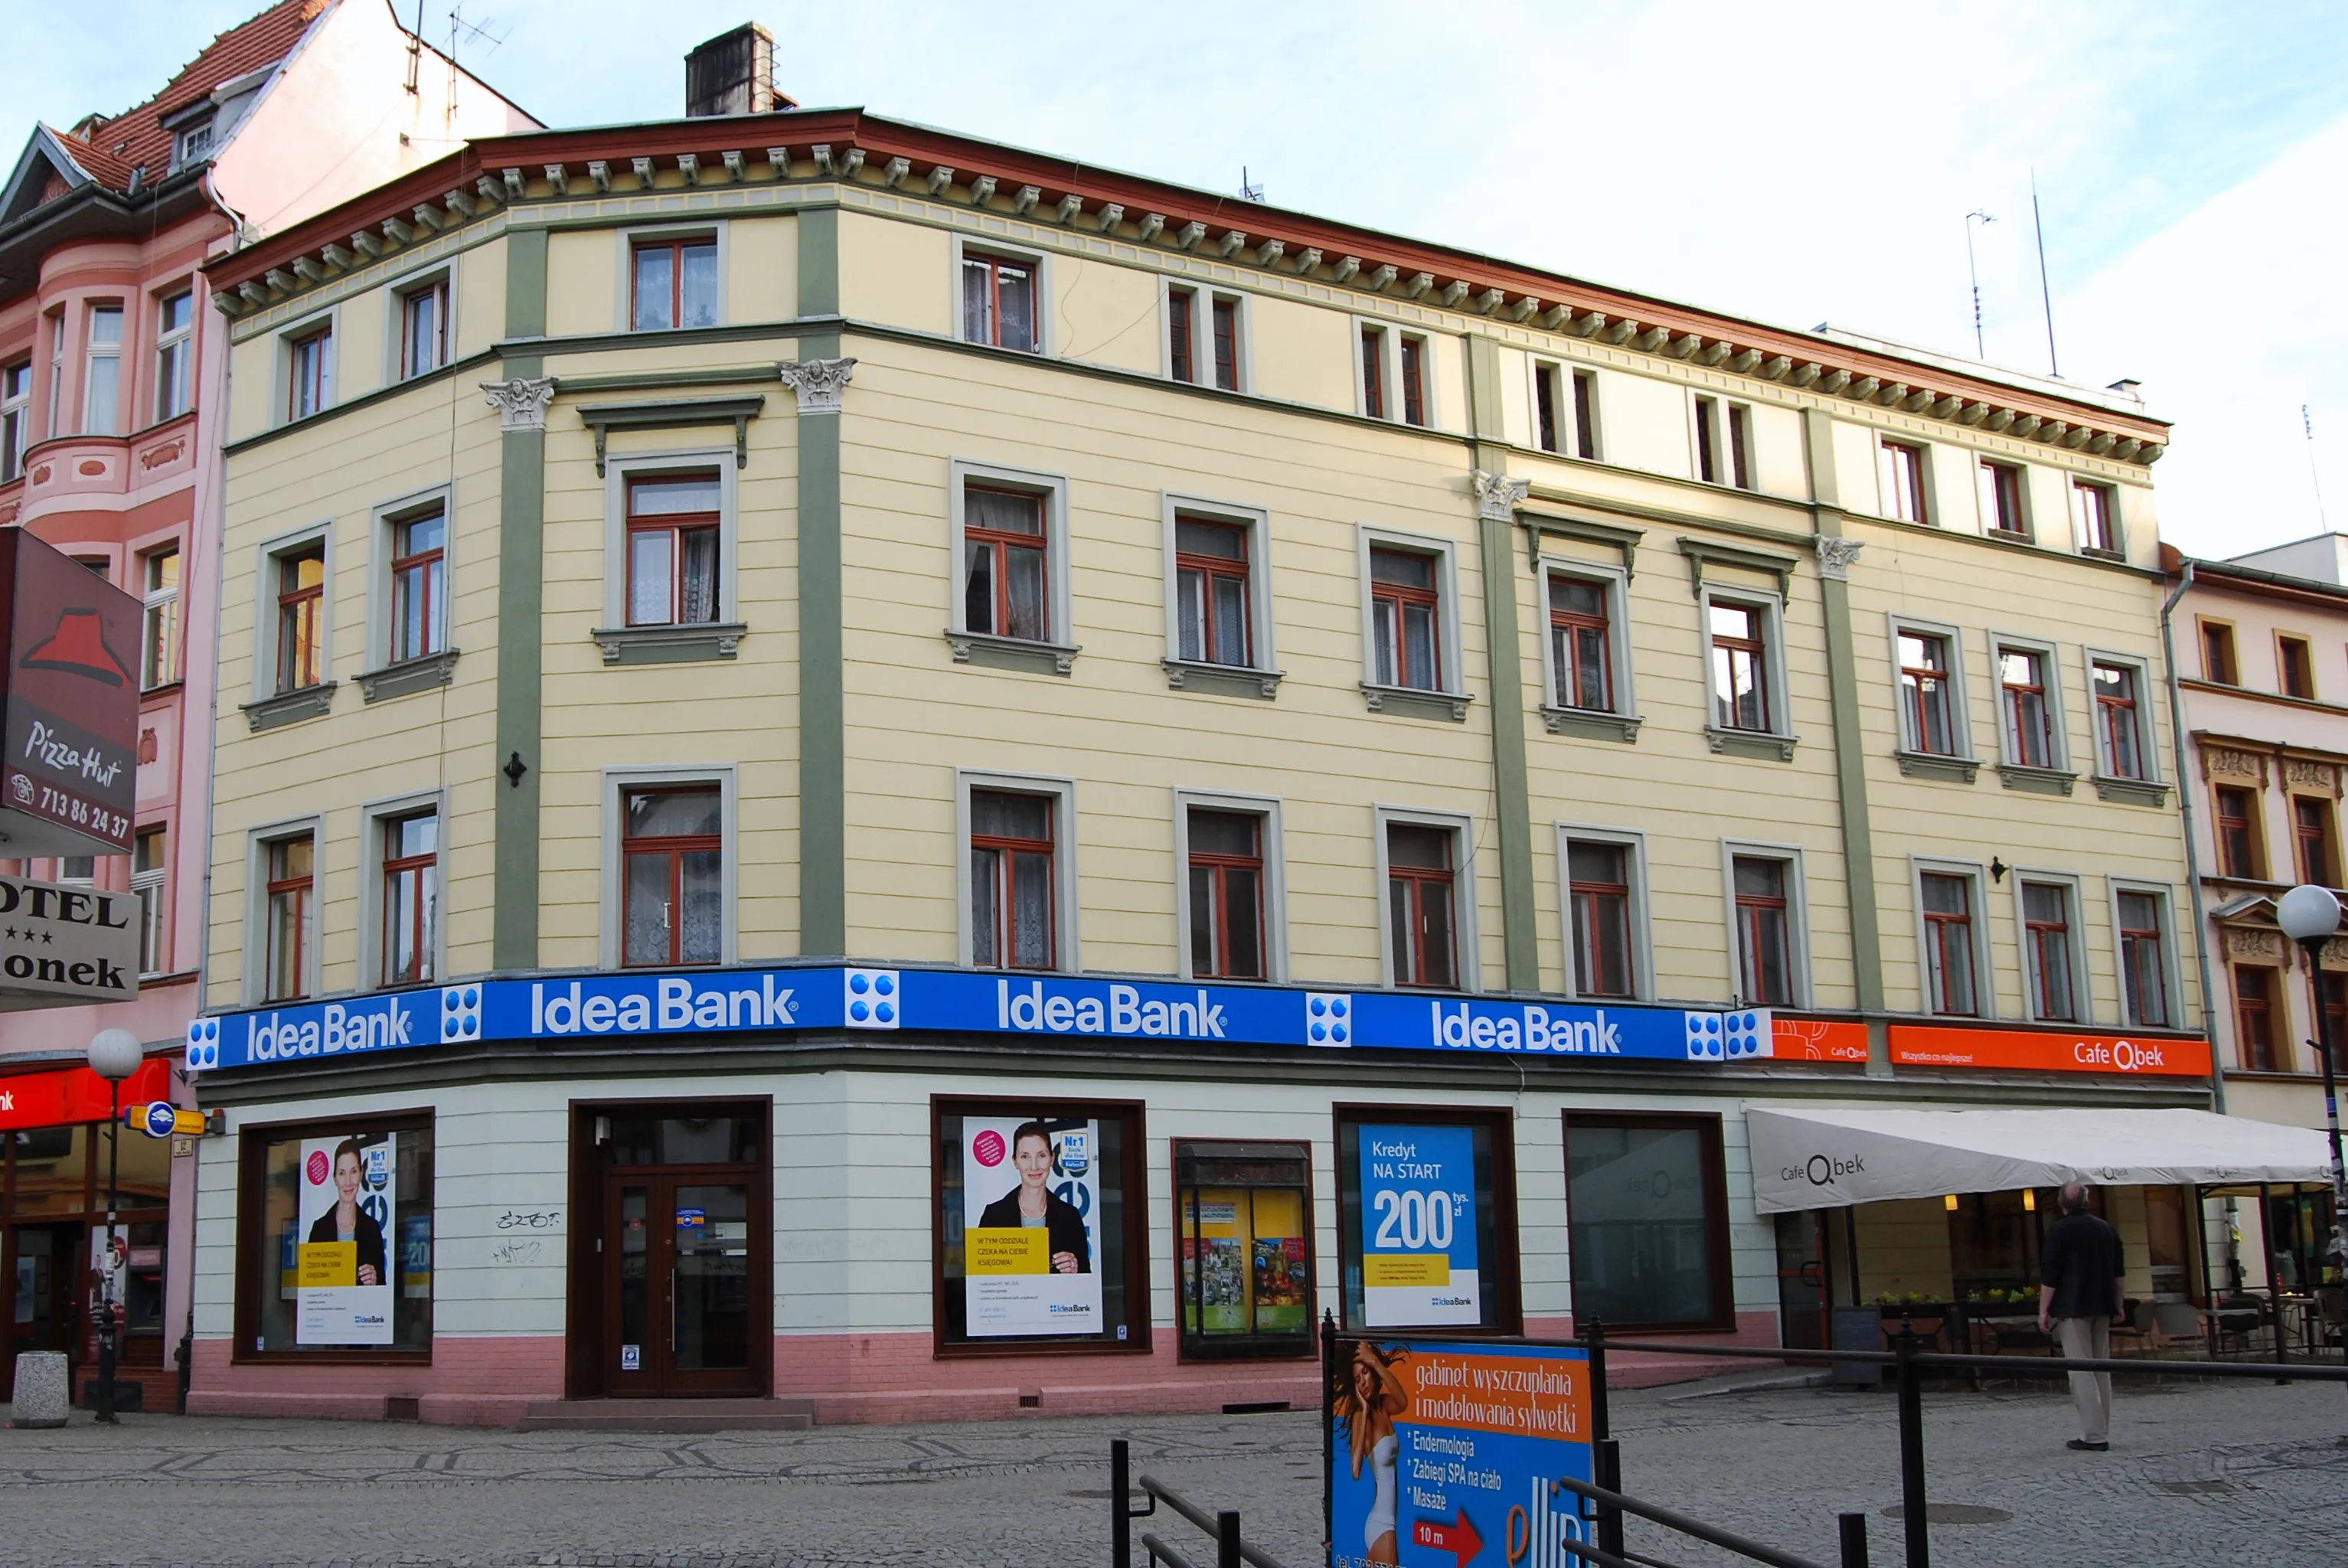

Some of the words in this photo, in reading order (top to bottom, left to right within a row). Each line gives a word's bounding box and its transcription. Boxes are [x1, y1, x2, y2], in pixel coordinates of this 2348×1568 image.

[24, 720, 80, 770] Pizza
[82, 747, 122, 788] Hut
[41, 786, 67, 816] 713
[71, 799, 88, 824] 86
[91, 807, 109, 832] 24
[111, 815, 129, 839] 37
[0, 955, 126, 990] onek
[531, 982, 650, 1034] Idea
[998, 979, 1105, 1033] Idea
[247, 1014, 319, 1061] Idea
[1432, 1001, 1521, 1050] Idea
[1830, 1047, 1847, 1057] Cafe
[1847, 1047, 1868, 1059] Qbek
[2074, 1043, 2110, 1063] Cafe
[2113, 1040, 2164, 1070] Qbek
[1065, 1136, 1077, 1146] Nr
[1078, 1137, 1083, 1146] 1
[1373, 1141, 1416, 1161] Kredyt
[1373, 1163, 1394, 1178] NA
[1398, 1164, 1442, 1179] START
[1781, 1165, 1804, 1181] Cafe
[1807, 1154, 1865, 1186] Qbek
[1453, 1192, 1469, 1204] tys.
[1374, 1190, 1453, 1249] 200
[1416, 1358, 1469, 1391] gabinet
[1472, 1364, 1572, 1401] wyszczuplania
[1416, 1390, 1420, 1416] i
[1423, 1393, 1514, 1426] modelowania
[1517, 1400, 1576, 1436] sylwetki
[1413, 1430, 1474, 1462] Endermologia
[1413, 1458, 1446, 1487] Zabiegi
[1448, 1462, 1466, 1485] SPA
[1468, 1470, 1478, 1487] na
[1481, 1468, 1502, 1491] ciało
[1413, 1485, 1446, 1511] Masaże
[1419, 1526, 1432, 1543] 10
[1433, 1532, 1443, 1545] m
